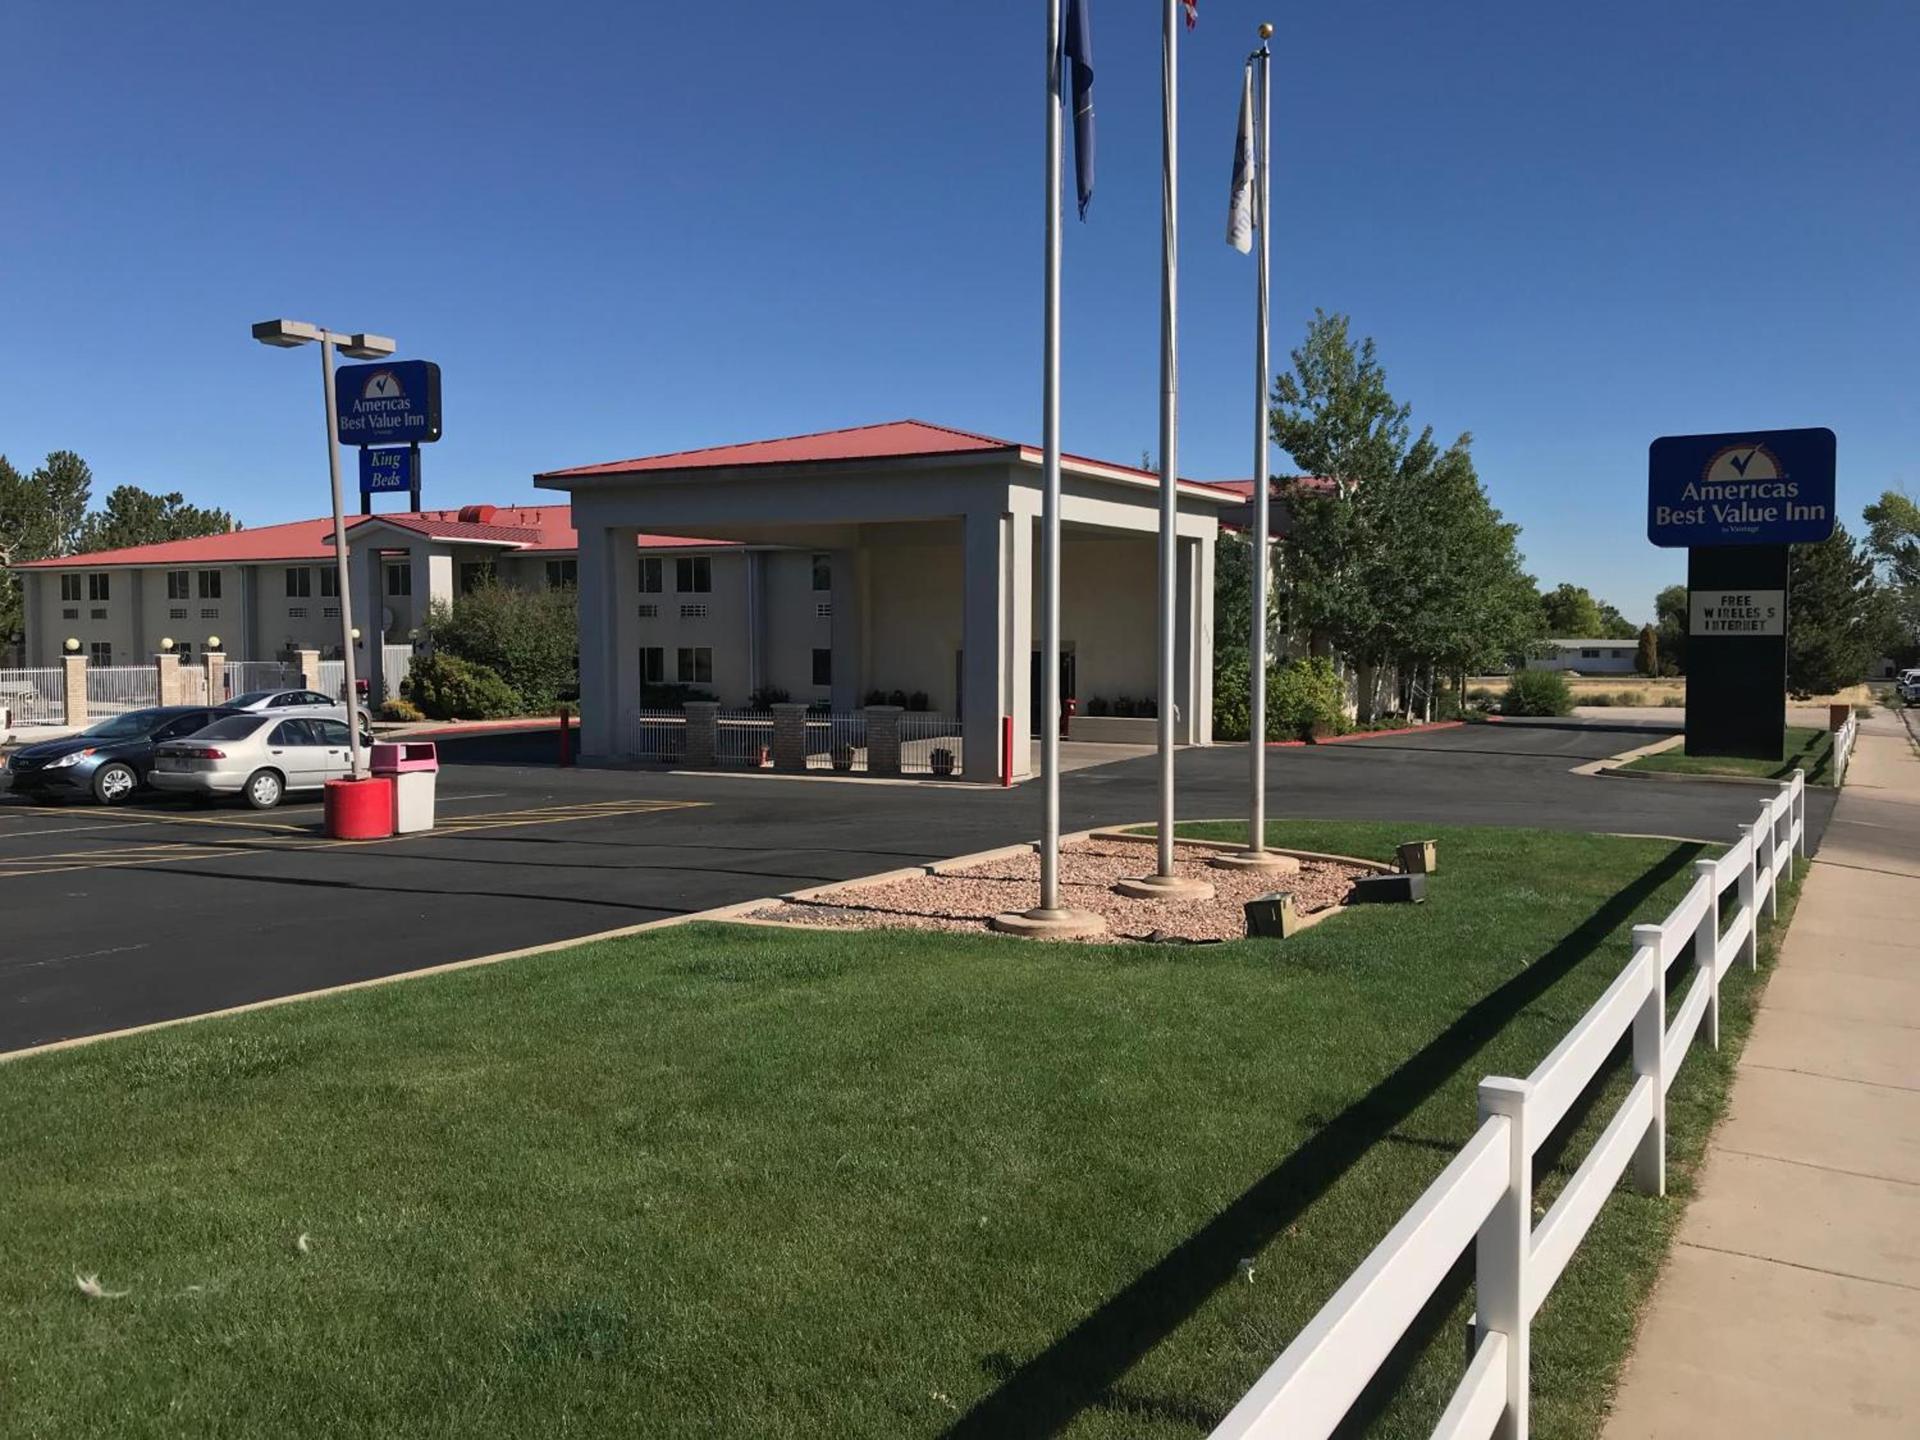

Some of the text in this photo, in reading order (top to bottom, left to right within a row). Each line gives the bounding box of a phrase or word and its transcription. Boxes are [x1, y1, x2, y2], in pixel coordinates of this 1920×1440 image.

[353, 398, 411, 413] Americas
[340, 412, 425, 430] Best Value Inn
[371, 451, 401, 469] King
[371, 471, 401, 487] Beds
[1681, 482, 1800, 501] Americas
[1656, 501, 1825, 525] Best Value Inn
[1721, 595, 1752, 607] FREE
